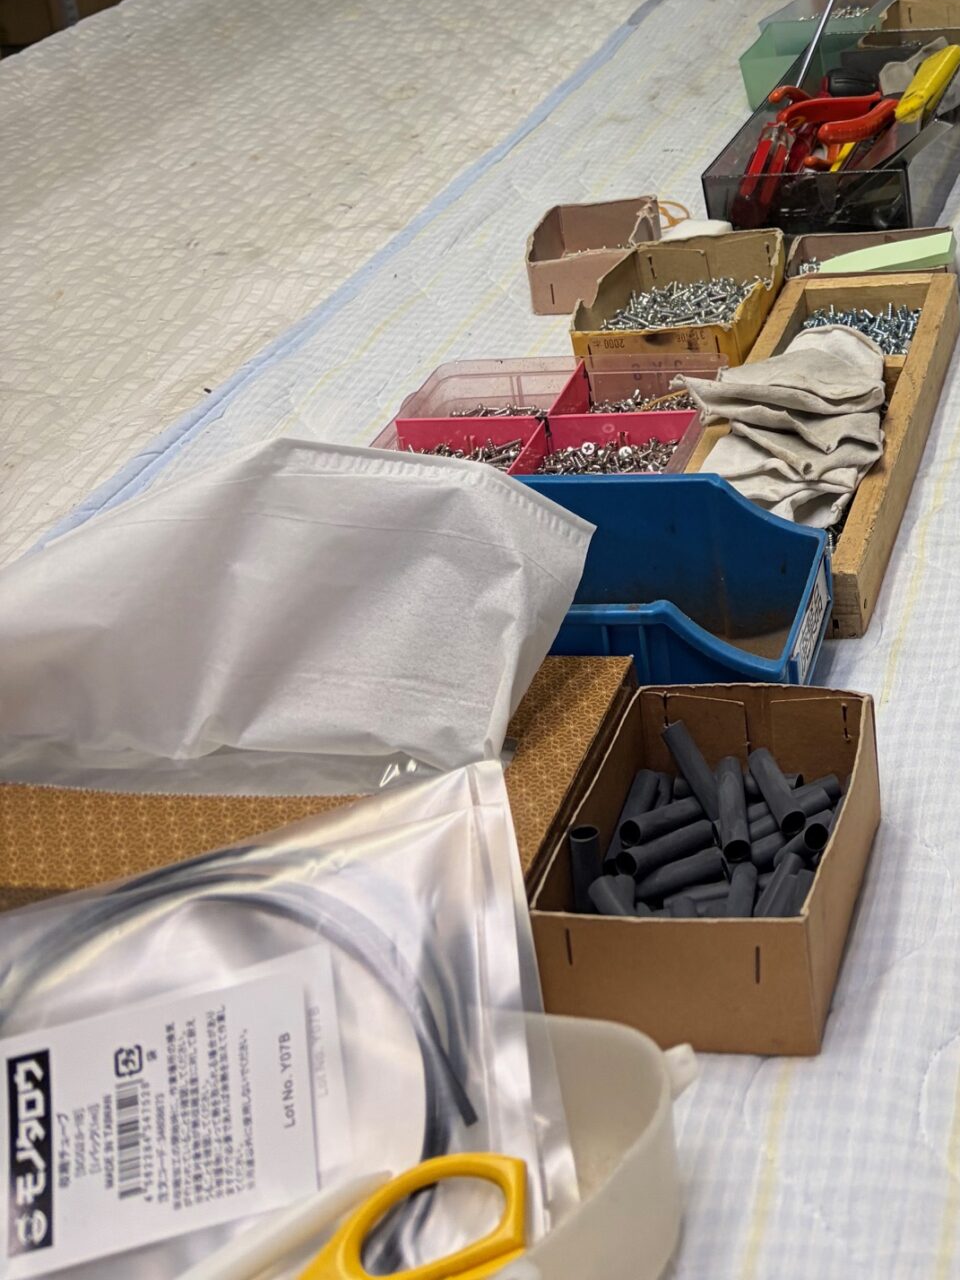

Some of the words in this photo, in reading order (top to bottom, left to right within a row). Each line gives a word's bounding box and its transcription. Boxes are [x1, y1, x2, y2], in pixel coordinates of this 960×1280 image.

[278, 1032, 291, 1073] Y07B
[281, 1077, 293, 1101] No.
[103, 1094, 113, 1137] TAIWAN
[283, 1104, 296, 1128] Lot
[15, 1060, 46, 1205] モノタロウ
[104, 1140, 113, 1152] IN
[105, 1156, 114, 1189] MADE
